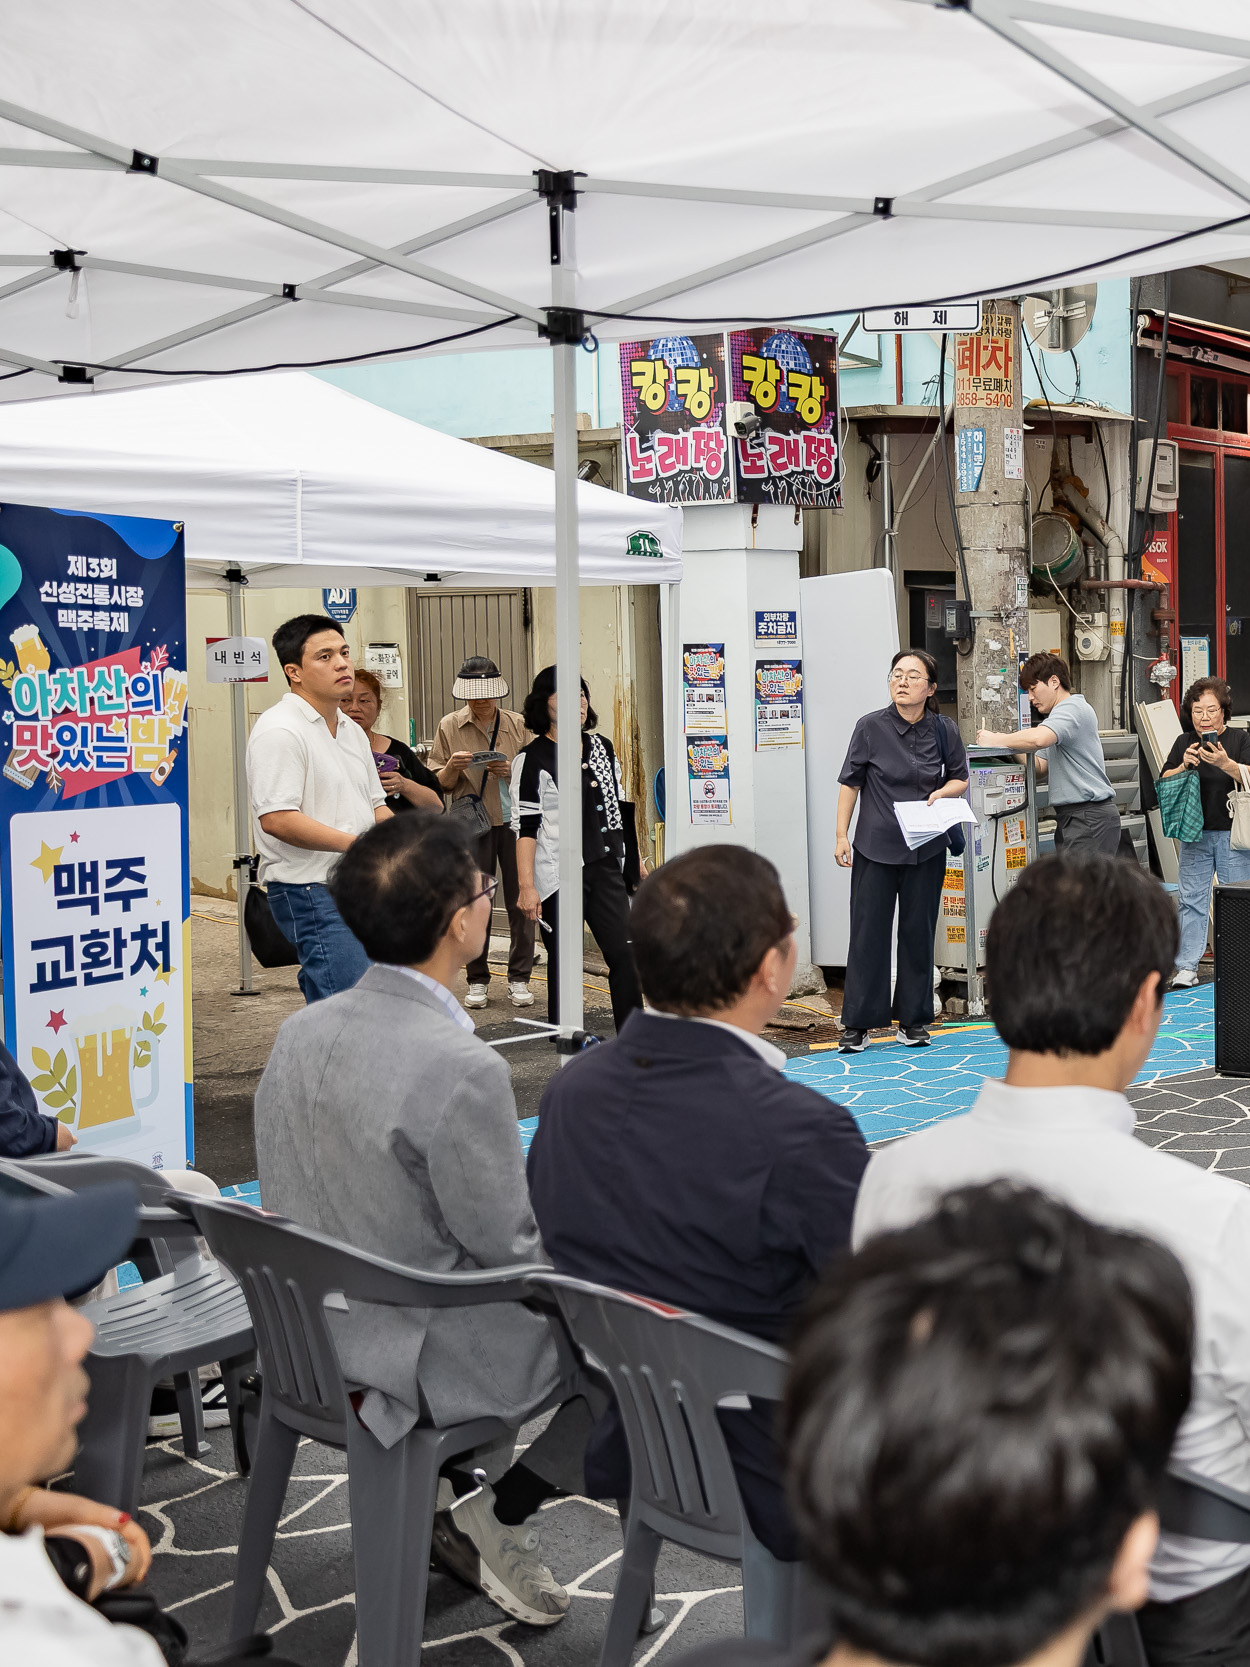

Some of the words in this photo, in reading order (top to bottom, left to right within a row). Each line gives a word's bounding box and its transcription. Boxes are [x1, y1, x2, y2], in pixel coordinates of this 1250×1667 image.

[957, 337, 1012, 379] 폐차
[628, 427, 726, 483] 노래짱
[67, 555, 117, 579] 제3회
[39, 581, 144, 607] 신성전통시장
[57, 609, 129, 632] 맥주축제
[758, 622, 795, 635] 주차금지
[763, 612, 790, 622] 외부차량
[689, 653, 716, 665] 아차산의
[761, 669, 792, 682] 아차산의
[12, 665, 165, 720] 아차산의
[693, 746, 720, 758] 아차산의
[54, 856, 148, 917] 맥주
[29, 920, 171, 994] 교환처
